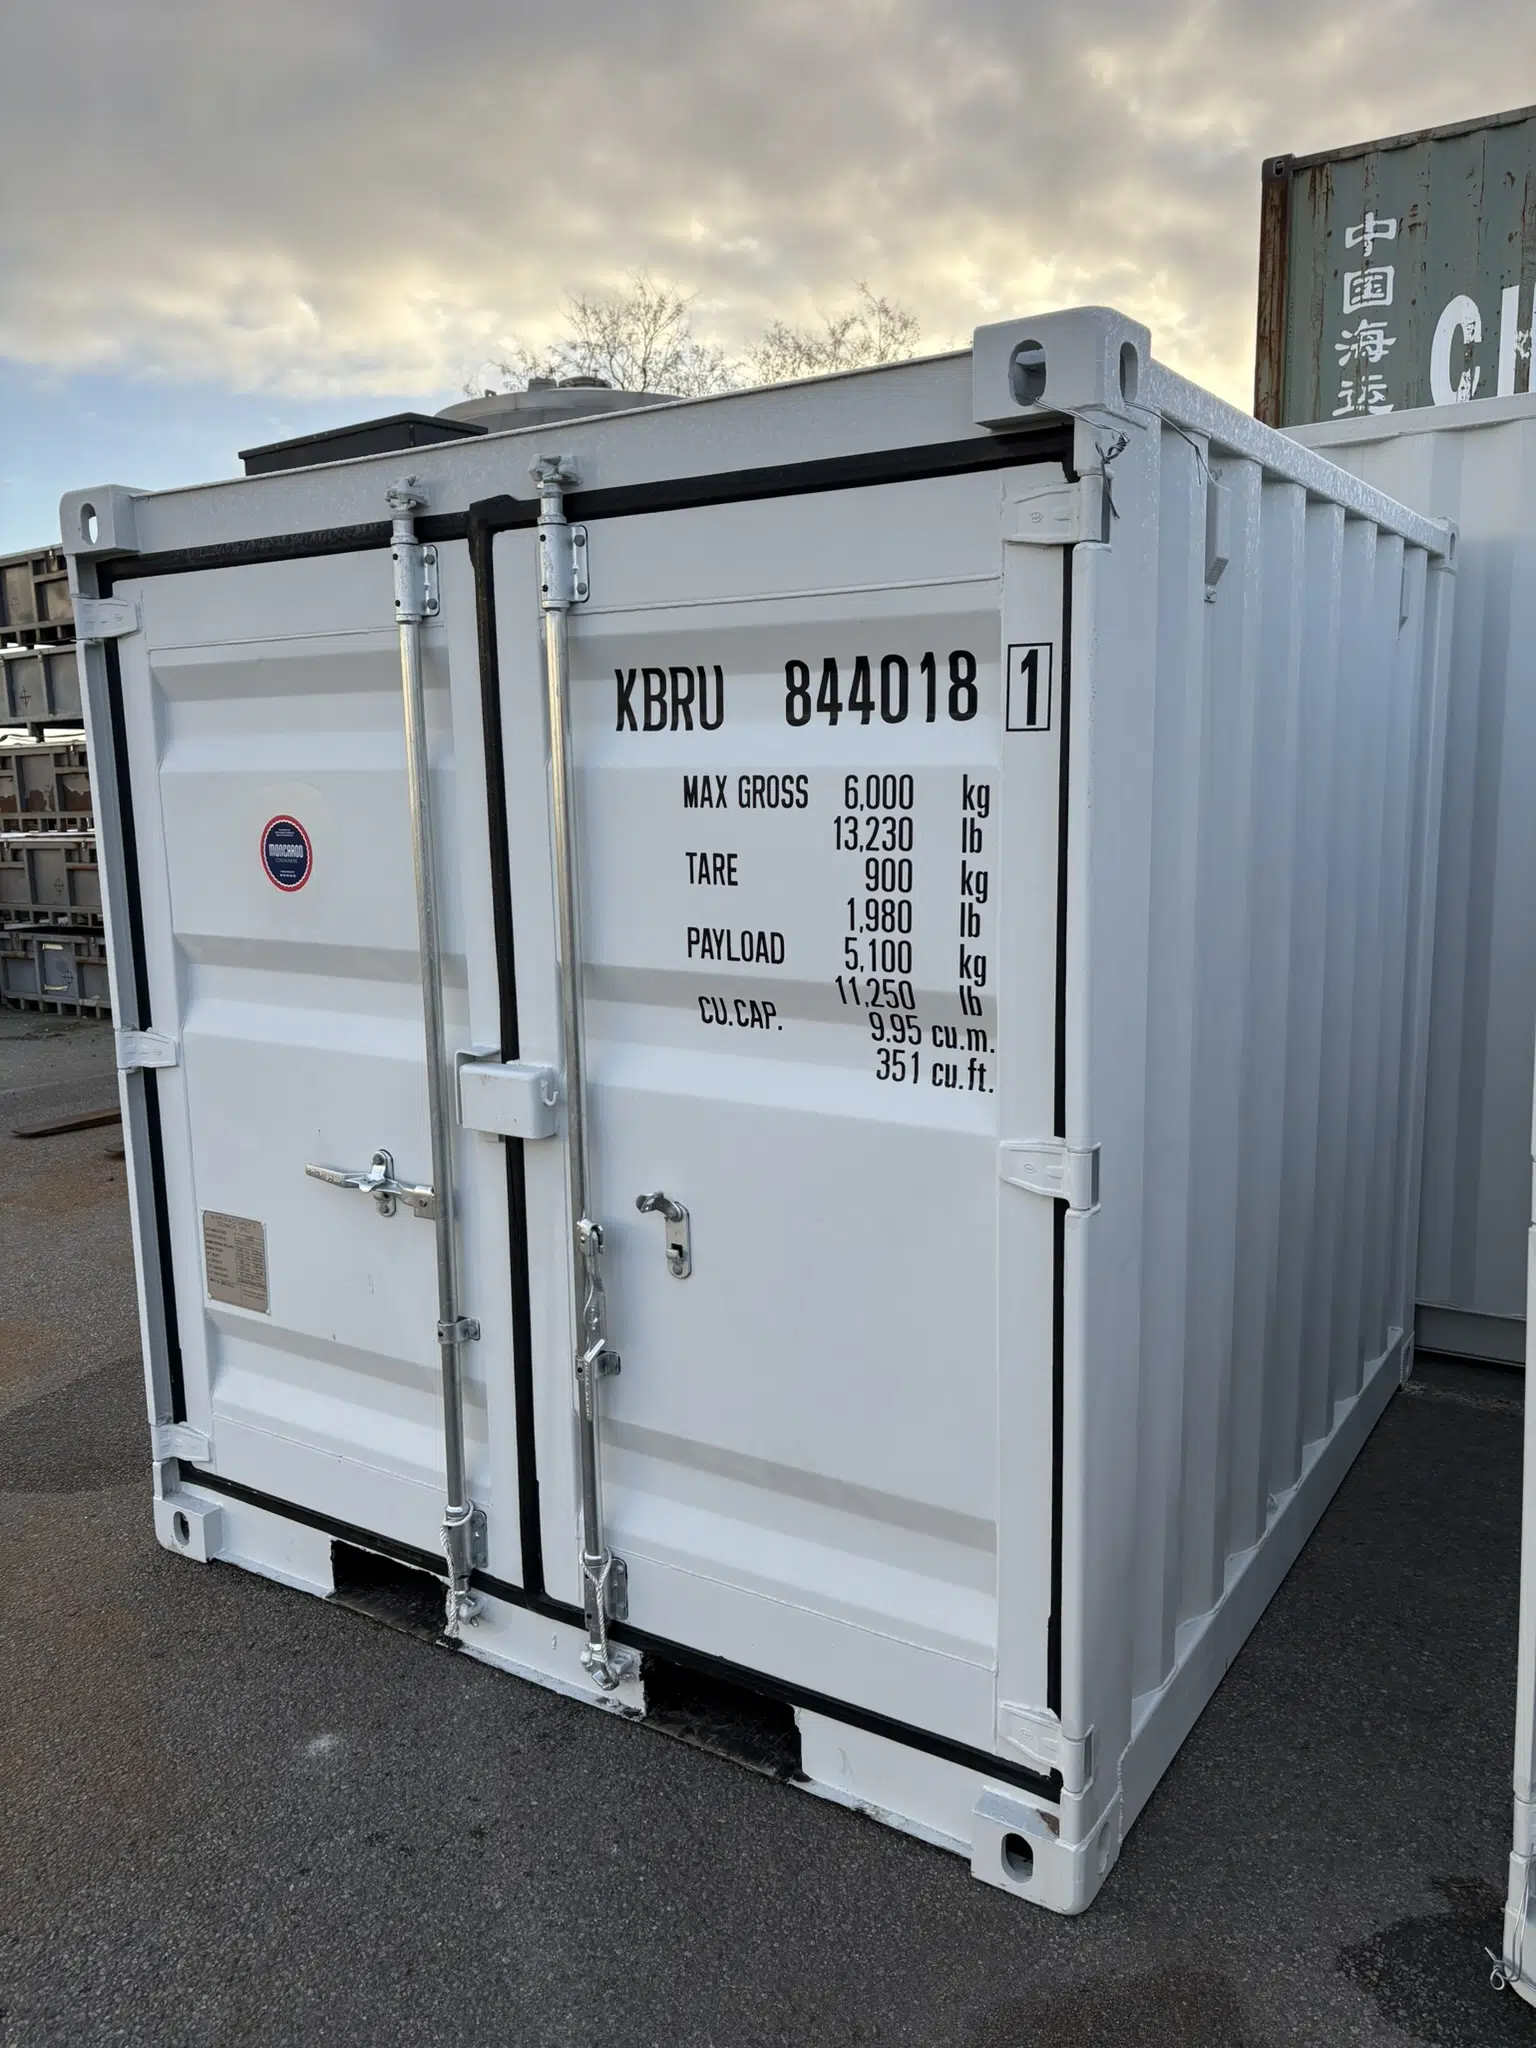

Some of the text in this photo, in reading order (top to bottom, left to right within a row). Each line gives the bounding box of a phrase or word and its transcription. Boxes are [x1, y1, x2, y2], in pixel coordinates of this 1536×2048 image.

[1333, 211, 1397, 416] 中国海运
[614, 648, 1039, 731] KBRU 844018 1
[683, 774, 990, 818] MAX GROSS 6,000 kg
[833, 815, 984, 853] 13,230 lb
[685, 852, 989, 904] TARE 900 kg
[847, 897, 981, 938] 1,980 lb
[687, 927, 987, 987] PAYLOAD 5,100 kg
[835, 975, 983, 1017] 11,250 lb
[698, 996, 995, 1054] CU.CAP. 9.95 cu.m.
[876, 1047, 994, 1094] 351 cu.ft.
